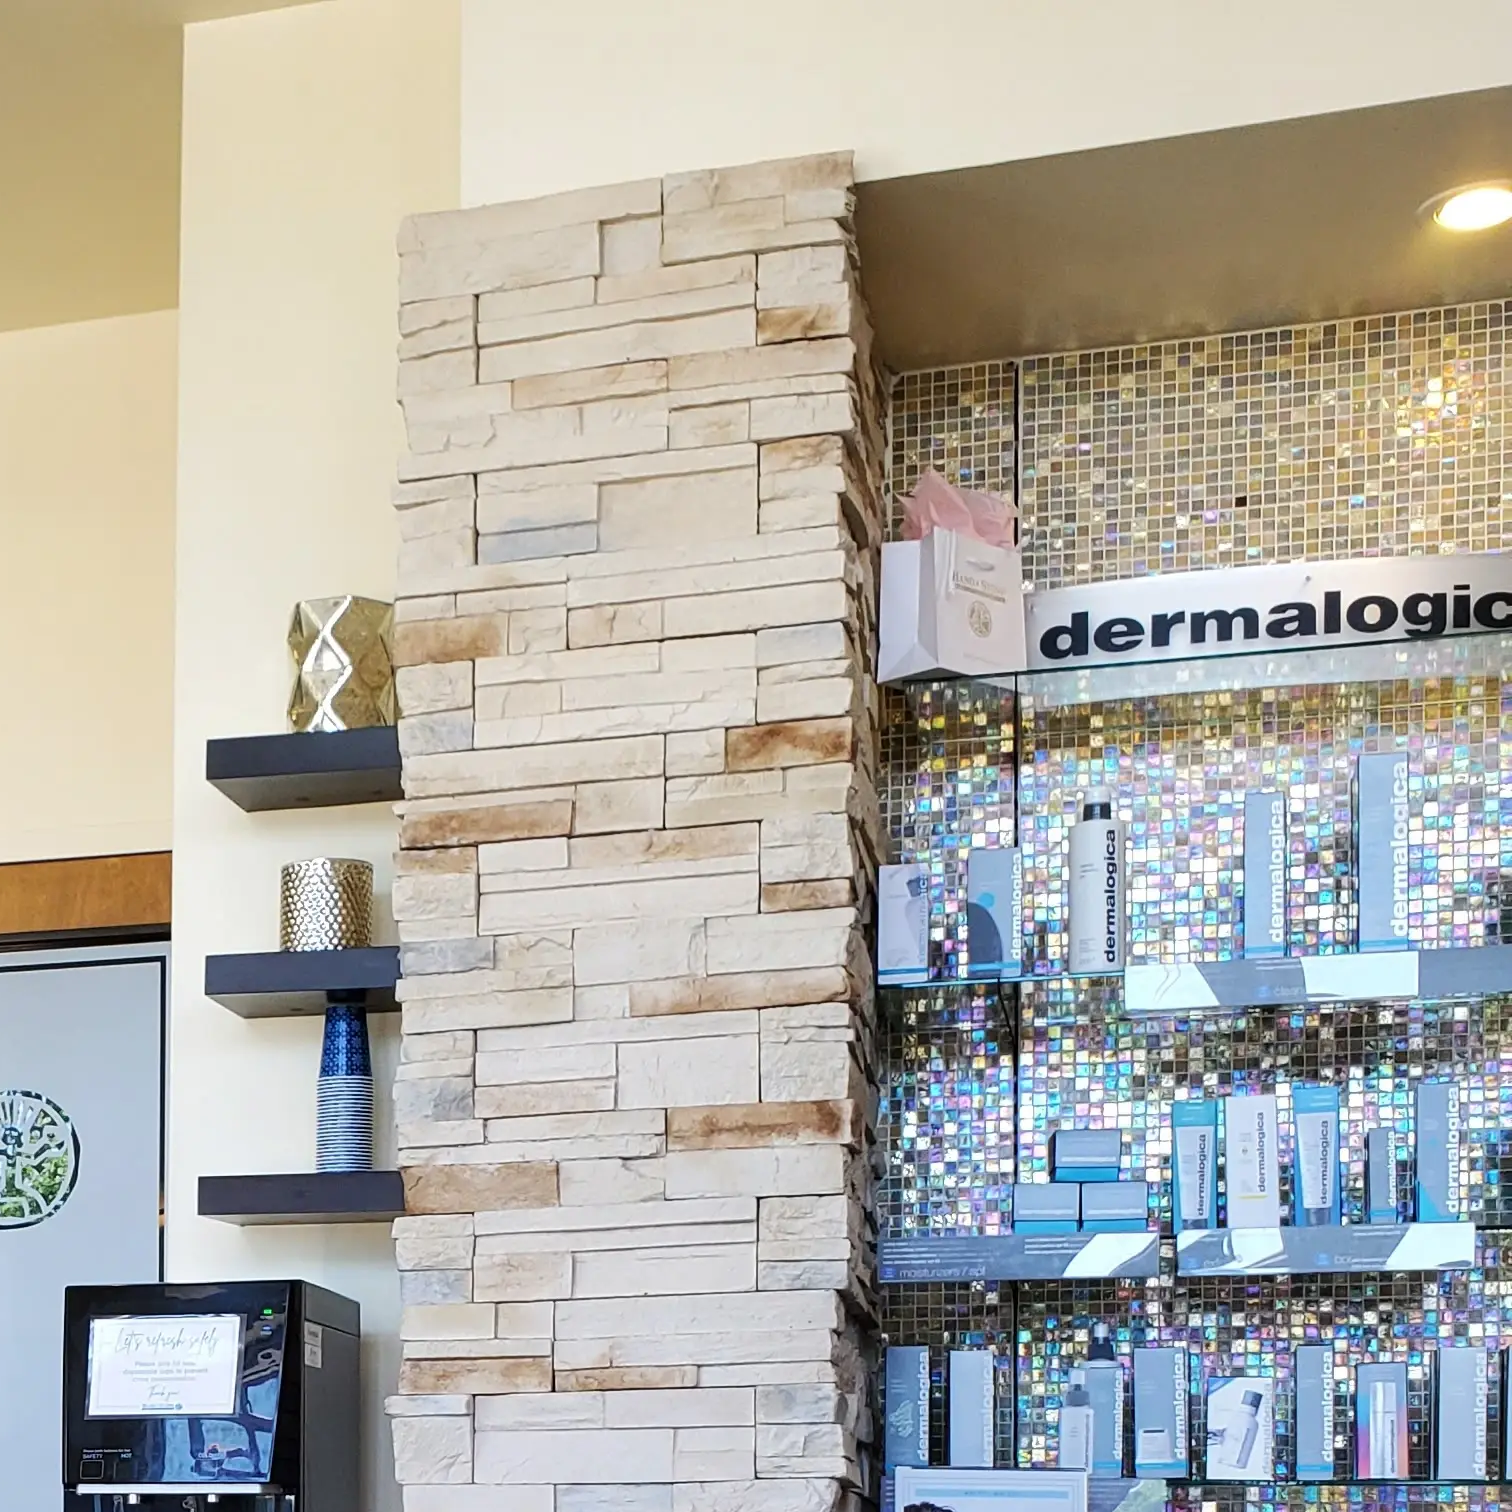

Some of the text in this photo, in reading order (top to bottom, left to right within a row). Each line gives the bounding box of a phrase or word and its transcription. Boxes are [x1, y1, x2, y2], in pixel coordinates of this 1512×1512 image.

[1039, 584, 1512, 659] dermalogic
[1104, 829, 1117, 963] dermalogica
[1269, 801, 1284, 942] dermalogica
[1389, 761, 1408, 936] dermalogica
[1011, 853, 1022, 960] dermalogica
[1197, 1134, 1207, 1216] dermalogica
[1256, 1112, 1266, 1192] dermalogica
[1320, 1120, 1329, 1205] dermalogica
[1387, 1131, 1396, 1206] dermalogica
[1446, 1087, 1459, 1213] dermalogica
[918, 1352, 929, 1460] dermalogica
[982, 1356, 994, 1464] ermalogica
[1113, 1370, 1124, 1460] dermalogica
[1173, 1354, 1189, 1459] dermalogica
[1322, 1352, 1333, 1461] dermalogica
[1473, 1352, 1487, 1475] dermalogica
